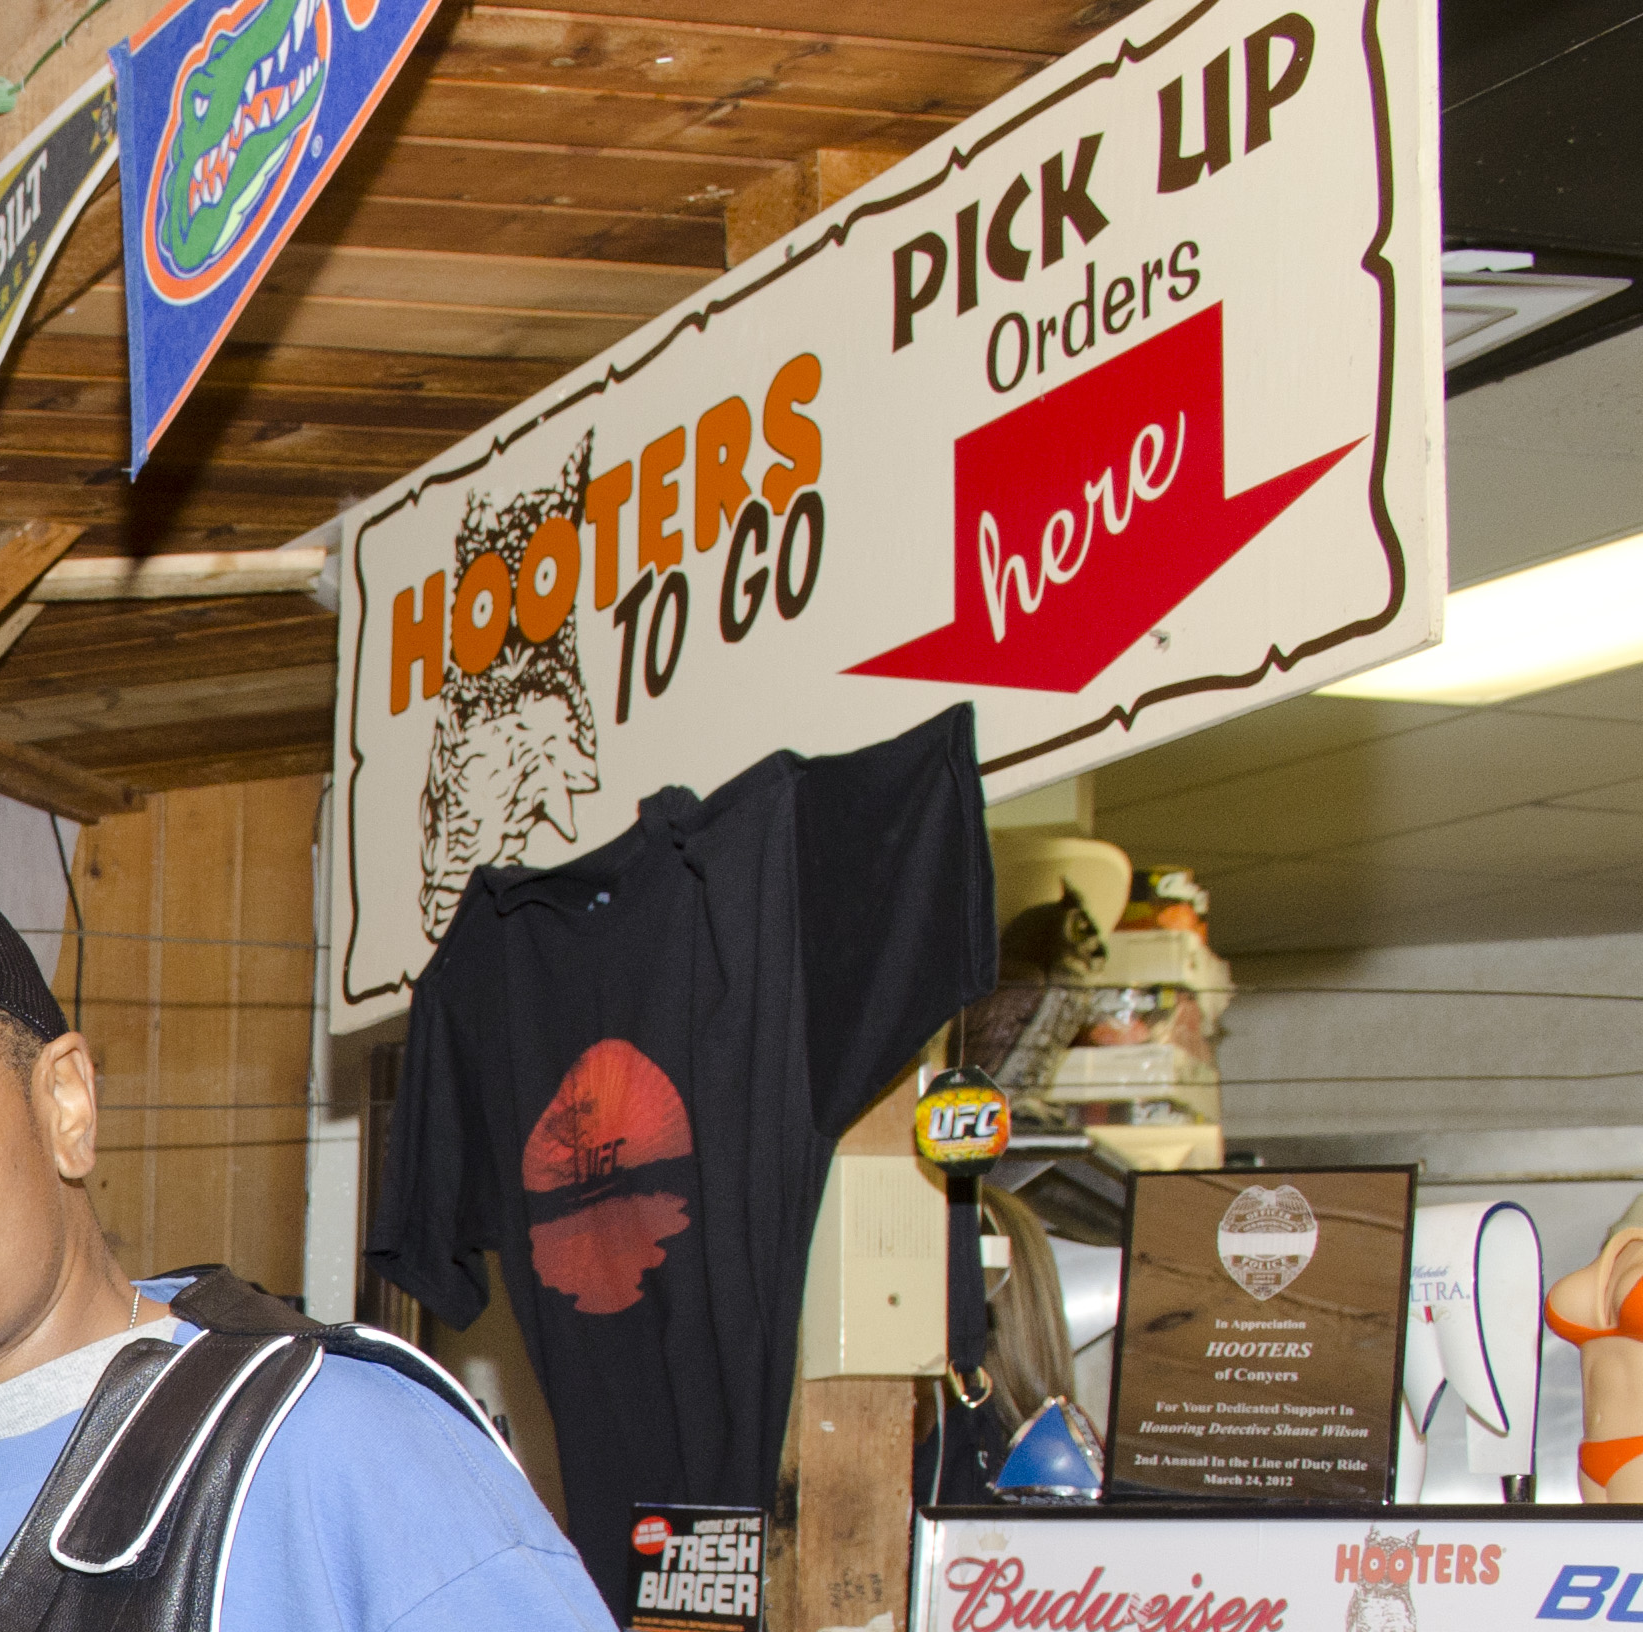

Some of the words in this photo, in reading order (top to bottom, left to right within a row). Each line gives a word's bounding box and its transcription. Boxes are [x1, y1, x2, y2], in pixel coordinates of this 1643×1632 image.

[890, 132, 1110, 354] PICK
[1156, 10, 1318, 195] UP
[986, 239, 1203, 396] Orders
[389, 350, 825, 718] HOOTERS
[978, 410, 1188, 645] here
[614, 566, 690, 725] TO
[719, 488, 827, 645] GO
[928, 1101, 1002, 1140] UFC
[1215, 1320, 1227, 1329] In
[1231, 1320, 1306, 1331] Appreciation
[1206, 1342, 1313, 1357] HOOTERS
[1215, 1369, 1232, 1380] of
[1235, 1369, 1299, 1383] Conyers
[1156, 1402, 1179, 1412] For
[1183, 1403, 1212, 1413] Your
[1216, 1403, 1279, 1415] Dedicated
[1283, 1404, 1336, 1417] Support
[1340, 1405, 1354, 1416] In
[1140, 1421, 1206, 1437] Honoring
[1209, 1423, 1270, 1436] Detective
[1273, 1424, 1318, 1436] Shane
[1322, 1425, 1369, 1438] Wilson
[1134, 1454, 1158, 1466] 2nd
[1161, 1455, 1208, 1467] Annual
[1212, 1456, 1225, 1467] In
[1229, 1457, 1249, 1468] the
[1253, 1457, 1280, 1469] Line
[1284, 1458, 1300, 1469] of
[1302, 1459, 1333, 1472] Duty
[1337, 1459, 1368, 1471] Ride
[1204, 1474, 1242, 1485] March
[1245, 1475, 1263, 1487] 24,
[1266, 1476, 1294, 1487] 2012
[661, 1534, 762, 1572] FRESH
[1335, 1542, 1503, 1586] HOOTERS
[637, 1571, 758, 1617] BURGER
